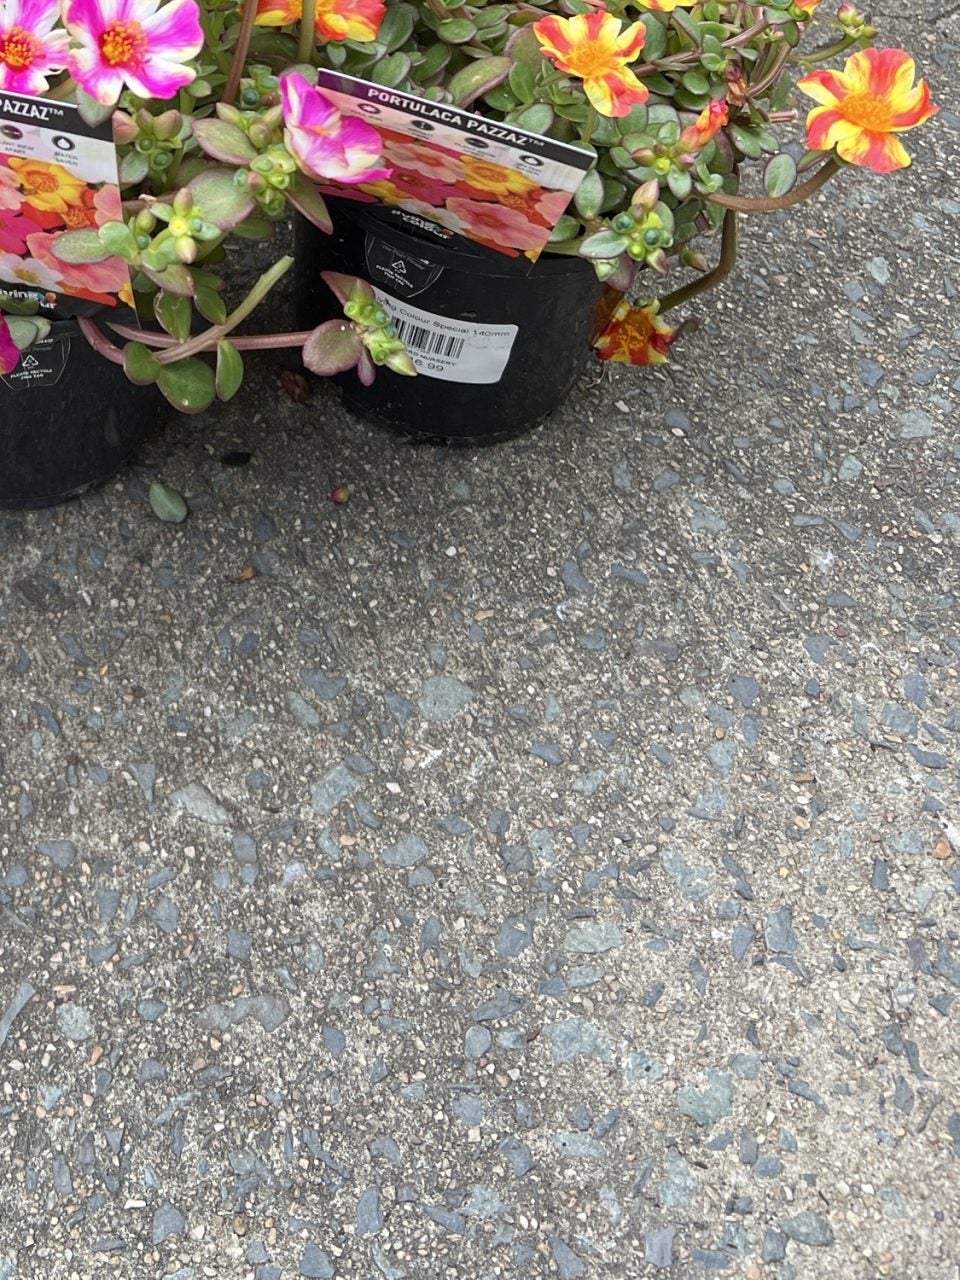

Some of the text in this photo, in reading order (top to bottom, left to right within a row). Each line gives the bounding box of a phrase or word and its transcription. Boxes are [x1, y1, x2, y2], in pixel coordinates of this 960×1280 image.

[368, 88, 462, 126] PORTULACA
[399, 309, 430, 324] Colour
[432, 321, 469, 334] Special
[419, 354, 456, 367] NURSERY
